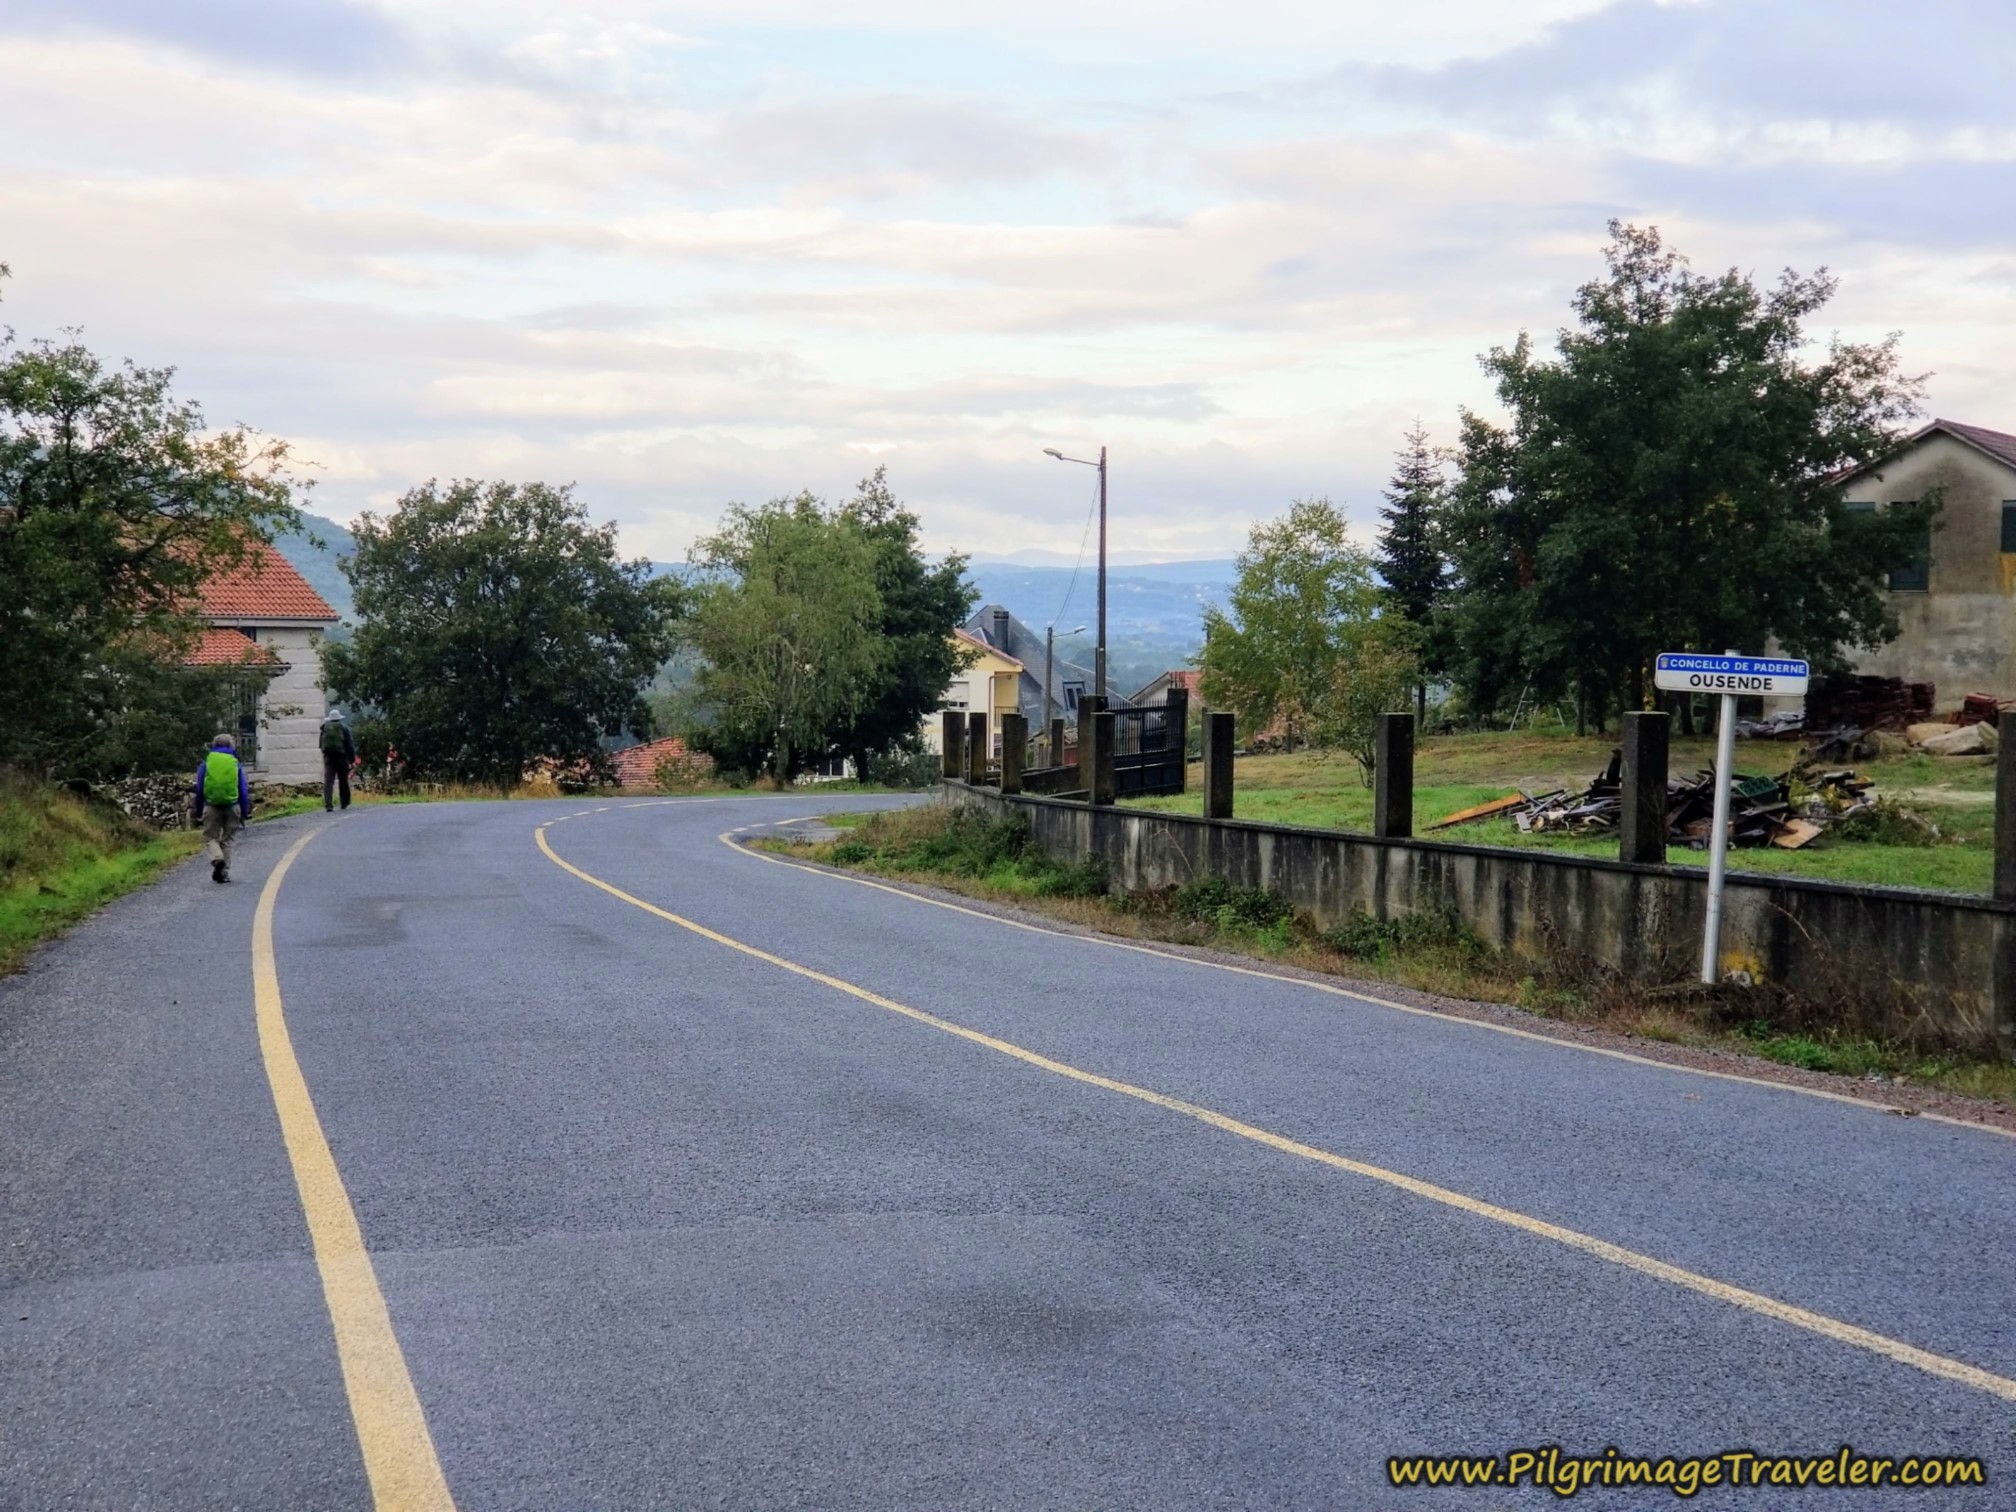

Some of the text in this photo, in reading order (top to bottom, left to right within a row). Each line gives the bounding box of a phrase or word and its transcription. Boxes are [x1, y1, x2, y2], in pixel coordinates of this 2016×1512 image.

[1670, 658, 1805, 674] CONCELLO DE PADERNE
[1690, 674, 1773, 690] OUSENDE
